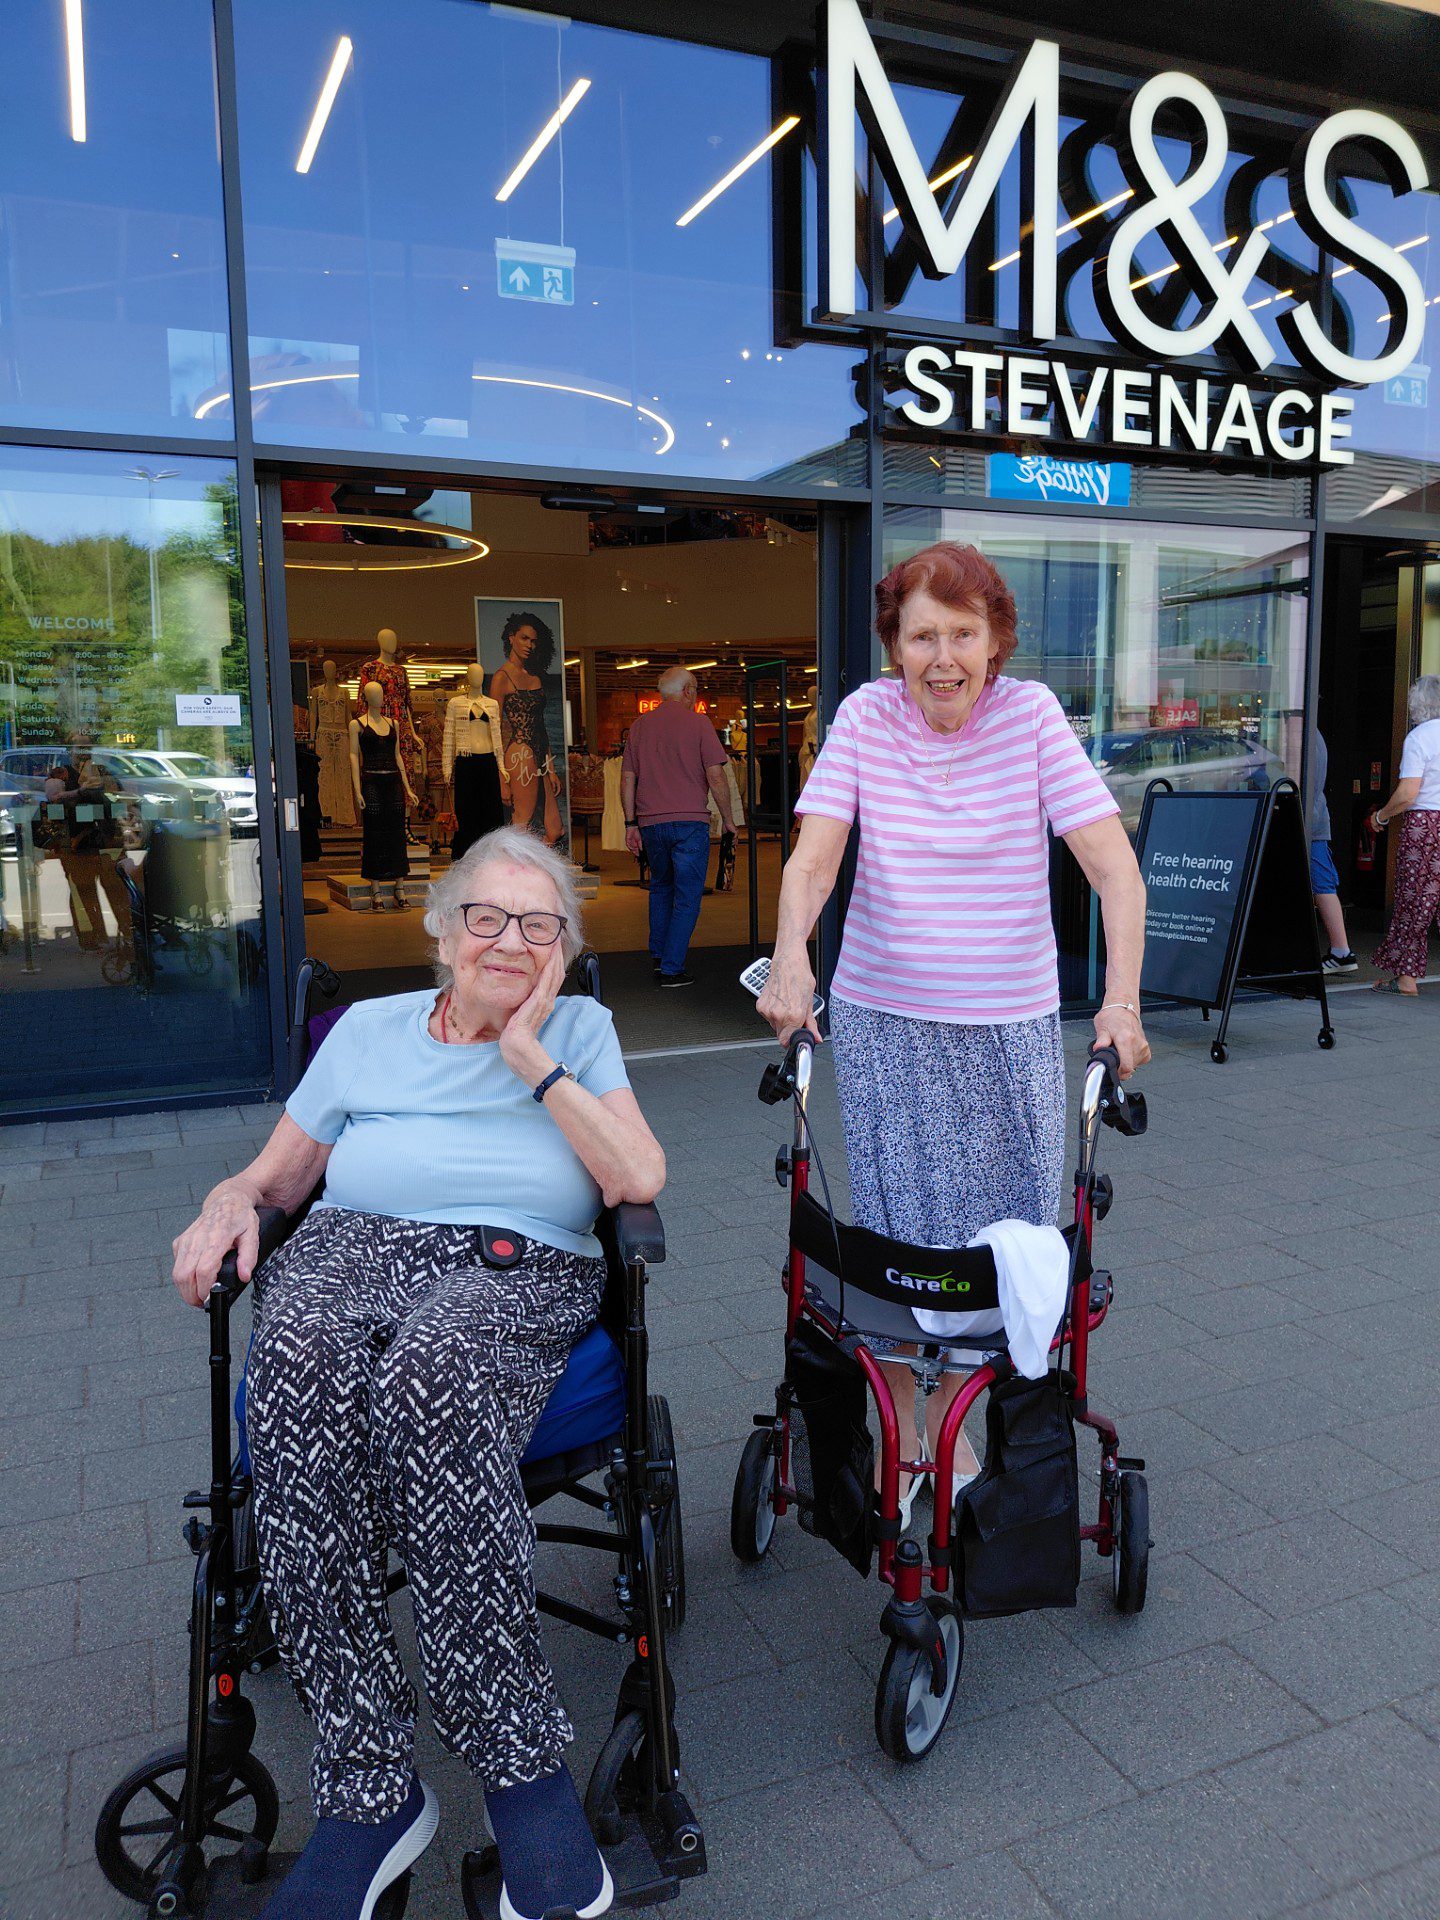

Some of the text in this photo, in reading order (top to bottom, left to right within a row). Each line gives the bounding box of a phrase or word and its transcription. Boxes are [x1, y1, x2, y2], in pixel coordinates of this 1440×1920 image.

[827, 0, 1429, 384] M&S
[901, 345, 1356, 466] STEVENAGE
[28, 616, 115, 630] WELCOME
[16, 650, 52, 659] Monday
[18, 664, 54, 673] Tuesday
[18, 677, 69, 686] Wednesday
[20, 703, 47, 711] Friday
[20, 715, 61, 725] Saturday
[21, 728, 55, 738] Sunday
[116, 733, 136, 743] Lift
[1152, 852, 1233, 874] Free hearing
[1147, 871, 1230, 892] health check
[1146, 909, 1216, 925] Discover better hearing
[1169, 922, 1185, 930] book
[1185, 924, 1206, 932] online
[885, 1267, 971, 1293] CareCo
